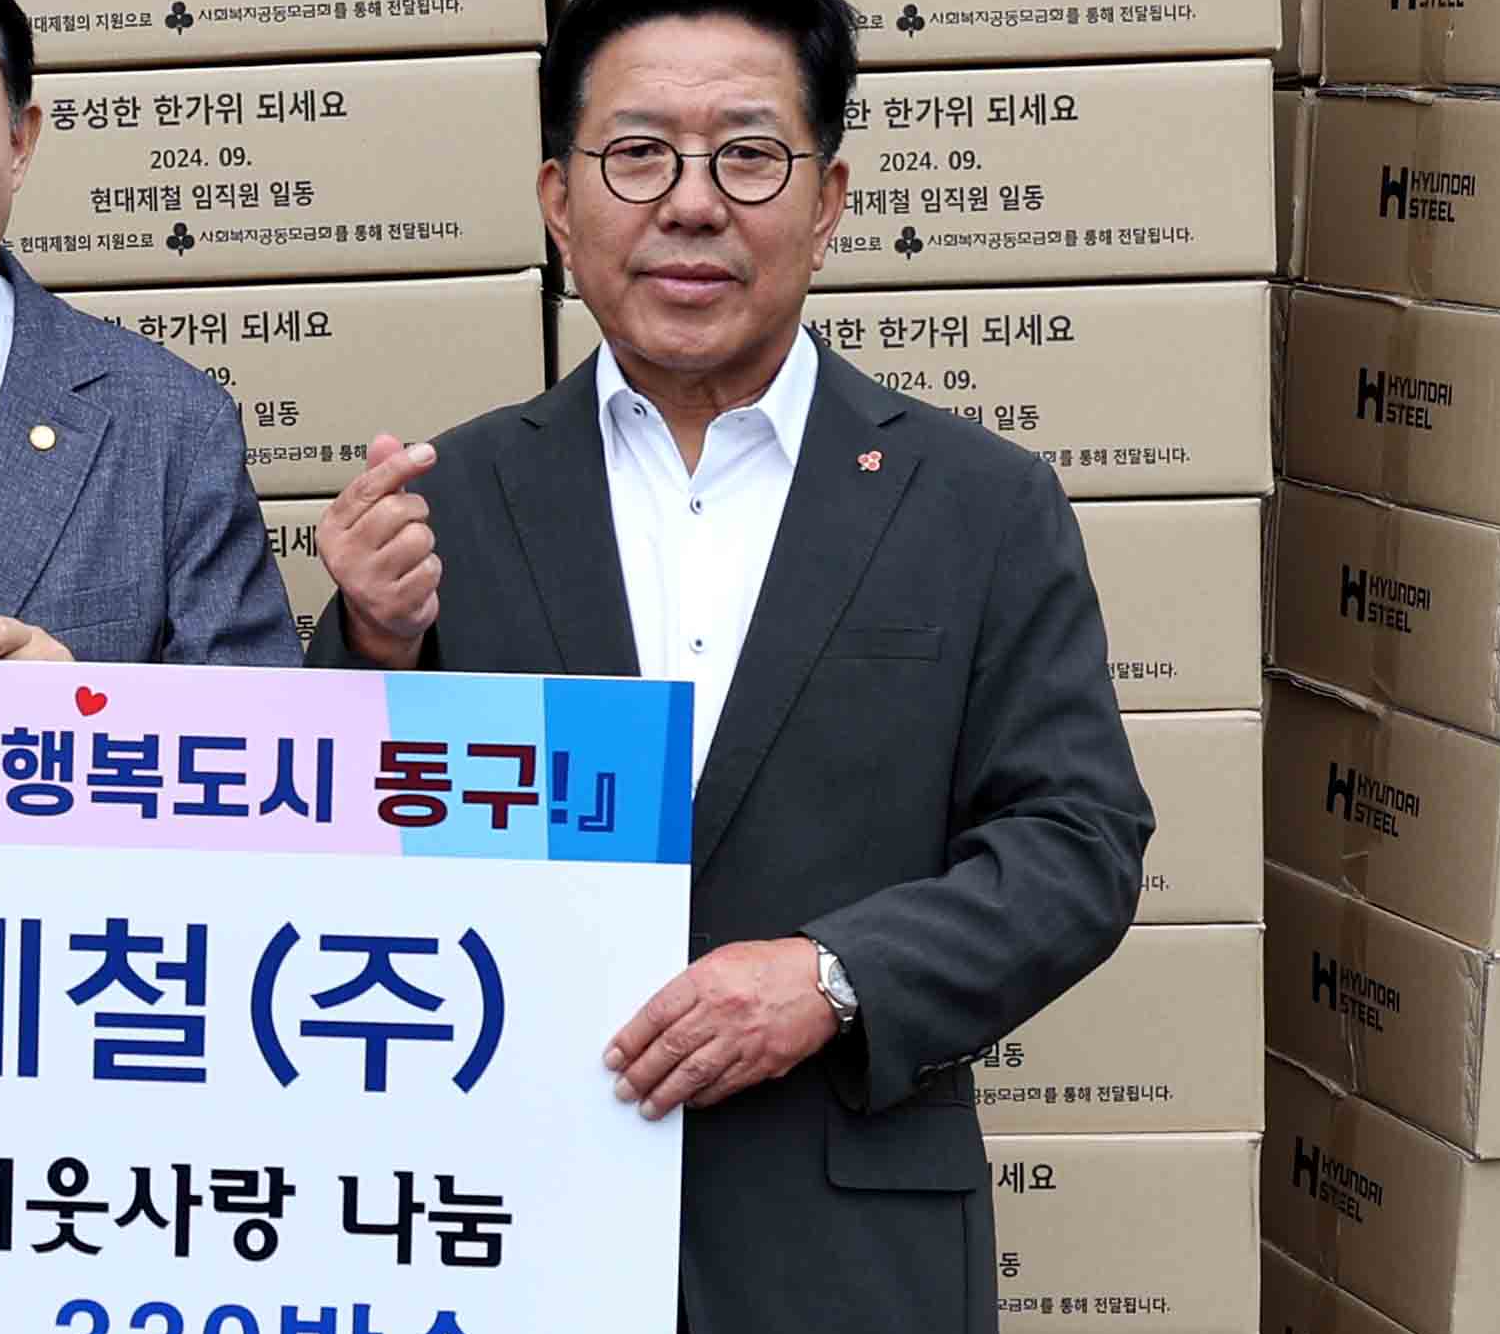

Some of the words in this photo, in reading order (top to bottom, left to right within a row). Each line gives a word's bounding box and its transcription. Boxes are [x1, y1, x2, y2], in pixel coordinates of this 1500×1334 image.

[1385, 402, 1433, 430] STEEL
[1387, 373, 1453, 407] HYUNDAI
[1, 727, 334, 823] 행복도시
[338, 1171, 512, 1268] 나눔
